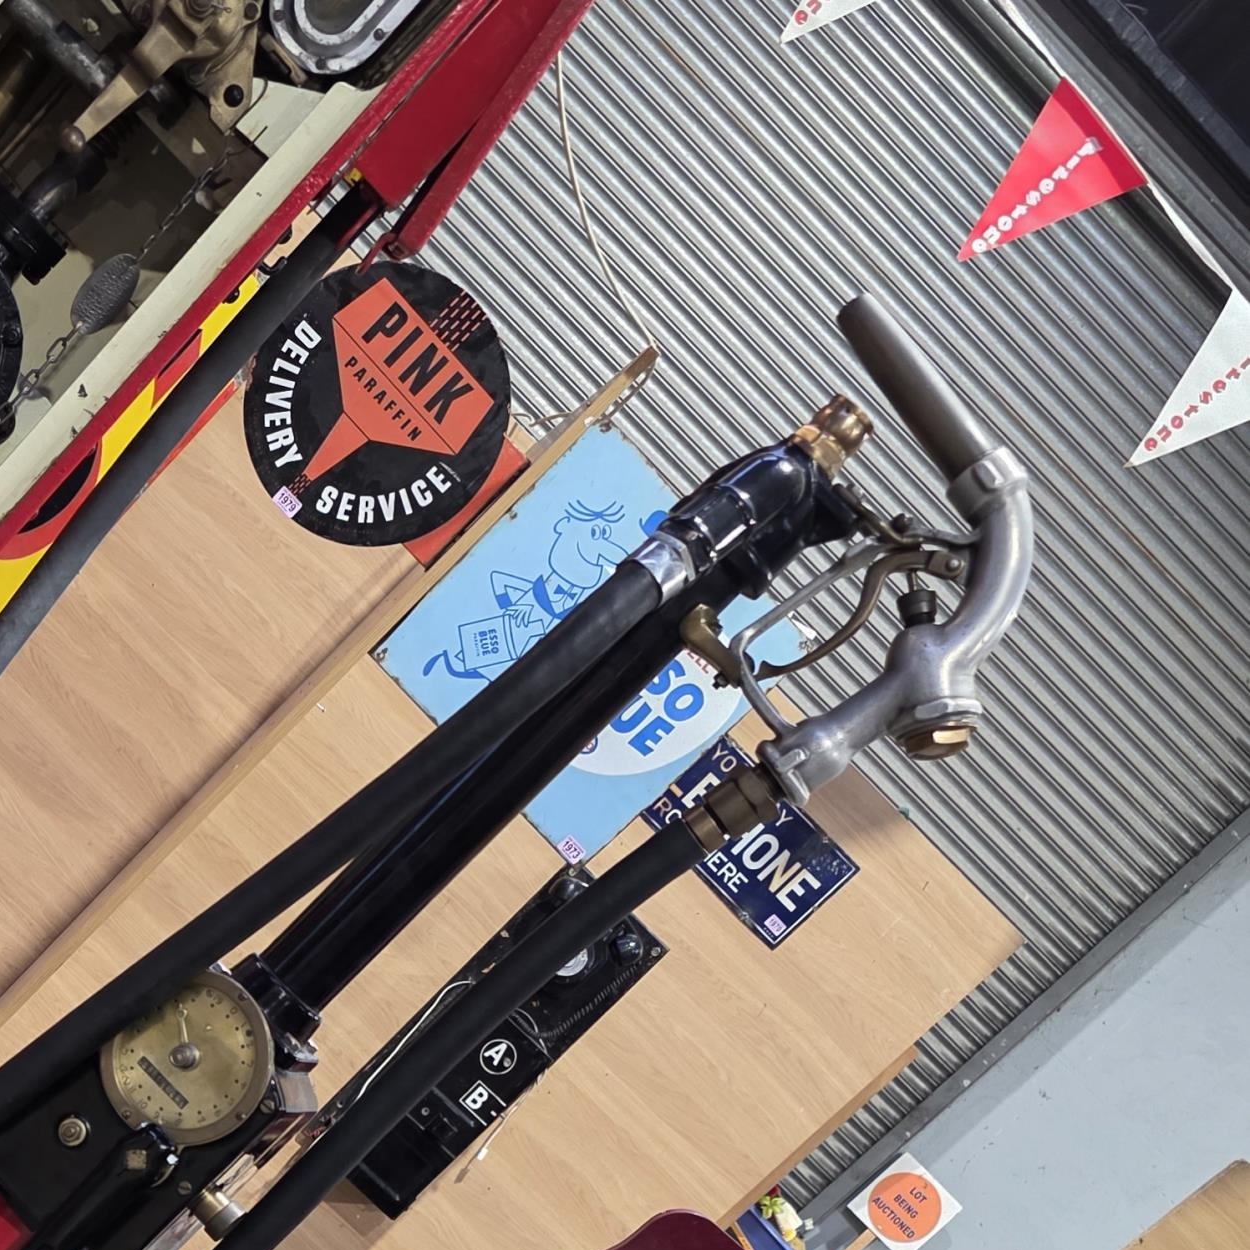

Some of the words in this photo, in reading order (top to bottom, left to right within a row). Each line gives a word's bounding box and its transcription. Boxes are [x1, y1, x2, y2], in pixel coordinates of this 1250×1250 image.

[361, 301, 474, 426] PINK
[344, 356, 422, 441] PARAFFIN
[1144, 356, 1250, 453] irestone
[264, 320, 322, 468] DELIVERY
[315, 466, 452, 524] SERVICE
[278, 492, 296, 513] 1979
[479, 630, 491, 656] BLUE
[488, 628, 499, 655] ESSO
[645, 660, 705, 722] SO
[610, 696, 675, 757] UE
[561, 839, 582, 859] 1973
[482, 1040, 507, 1066] A
[463, 1084, 489, 1112] B
[894, 1194, 919, 1219] BEING
[910, 1187, 927, 1204] LOT
[872, 1197, 915, 1239] AUCTIONED
